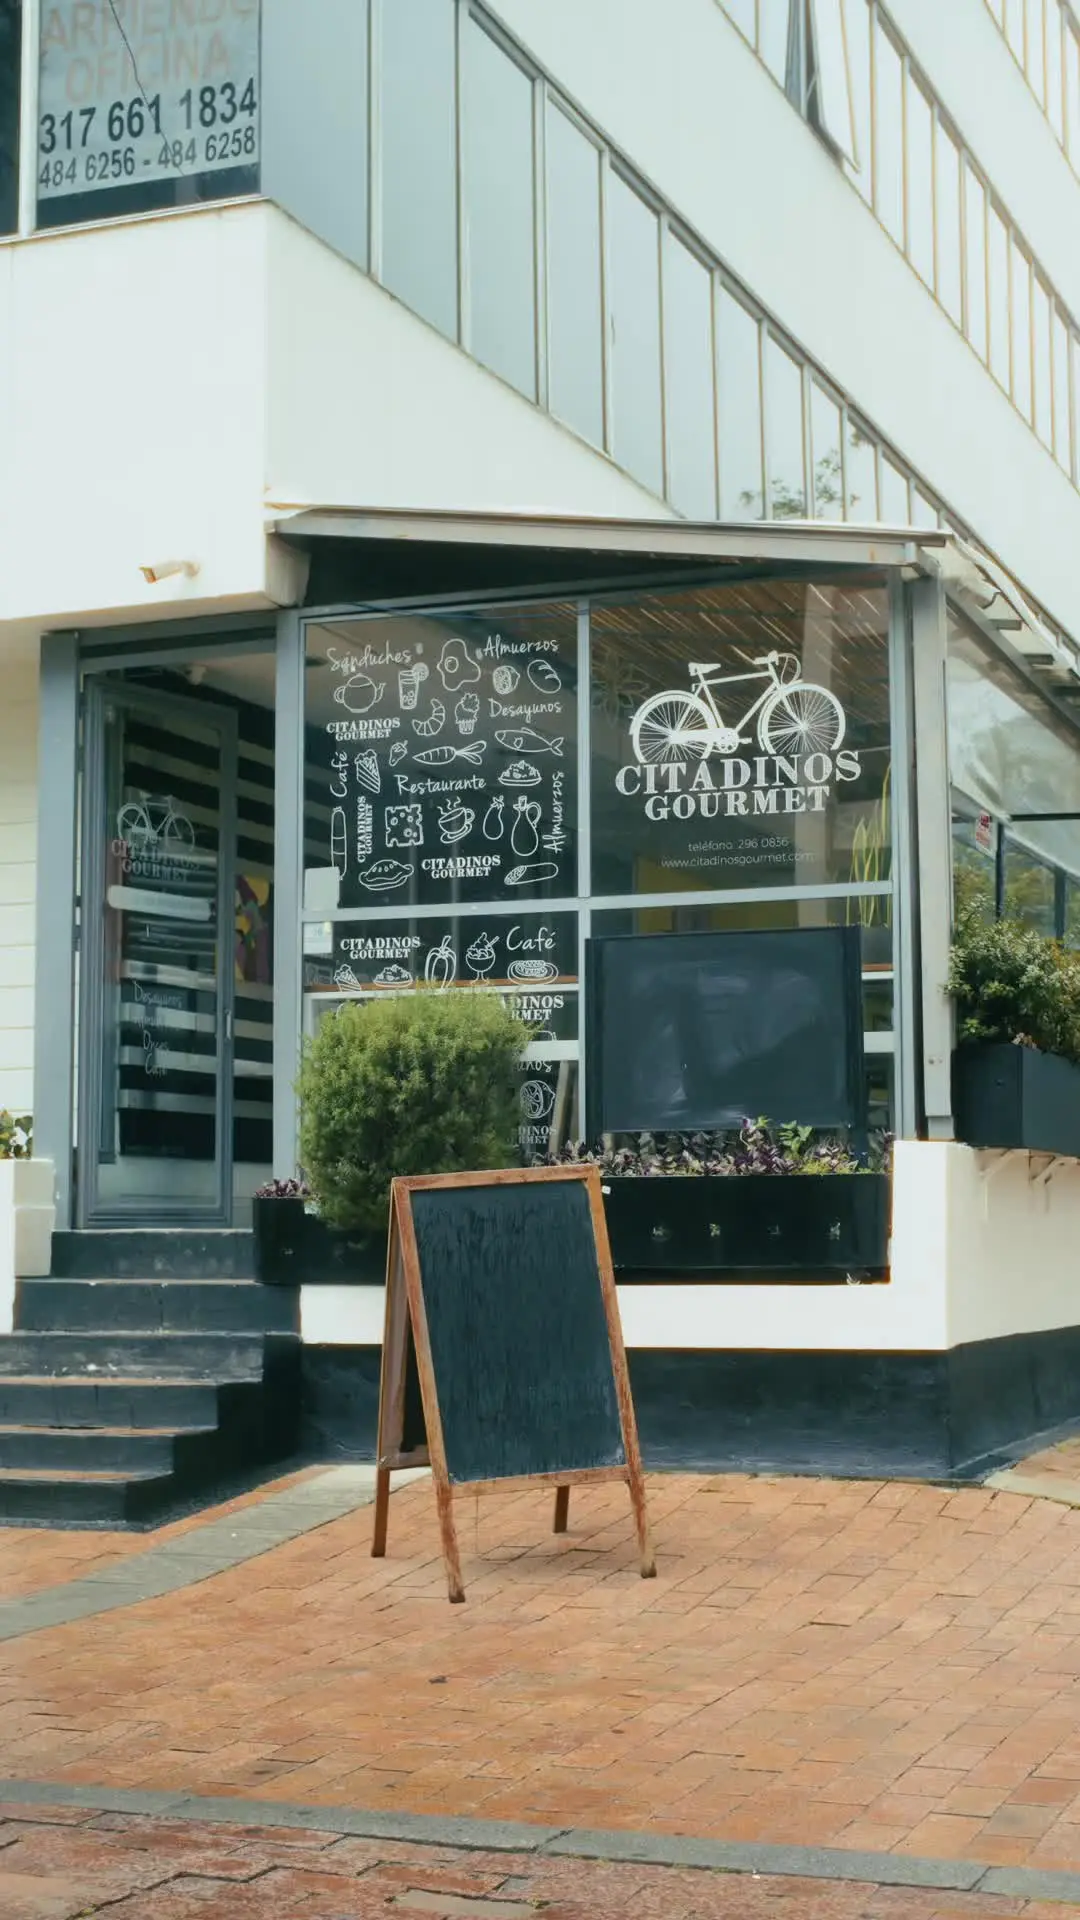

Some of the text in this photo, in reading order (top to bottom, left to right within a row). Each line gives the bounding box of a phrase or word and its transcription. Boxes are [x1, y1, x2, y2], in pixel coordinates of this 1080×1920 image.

[66, 28, 231, 104] OFICINA
[39, 77, 257, 154] 317 661 1834
[38, 157, 77, 189] 484
[84, 147, 136, 181] 6256
[157, 138, 197, 169] 484
[204, 126, 256, 162] 6258
[483, 634, 559, 659] Almuerzos
[488, 698, 562, 723] Desayunos
[326, 717, 401, 733] CITADINOS
[335, 729, 391, 741] GOURMET
[330, 750, 348, 798] Café
[394, 774, 487, 796] Restaurante
[615, 750, 862, 796] CITADINOS
[542, 770, 567, 853] Almuerzos
[644, 786, 830, 821] GOURMET
[357, 796, 366, 863] CITADINOS
[364, 803, 373, 854] GOURMET
[738, 838, 758, 849] 296
[421, 855, 501, 871] CITADINOS
[431, 867, 491, 879] GOURMET
[340, 936, 421, 950] CITADINOS
[506, 926, 556, 952] Café
[350, 948, 411, 959] GOURMET
[502, 995, 564, 1009] DINOS
[511, 1009, 552, 1020] RMET
